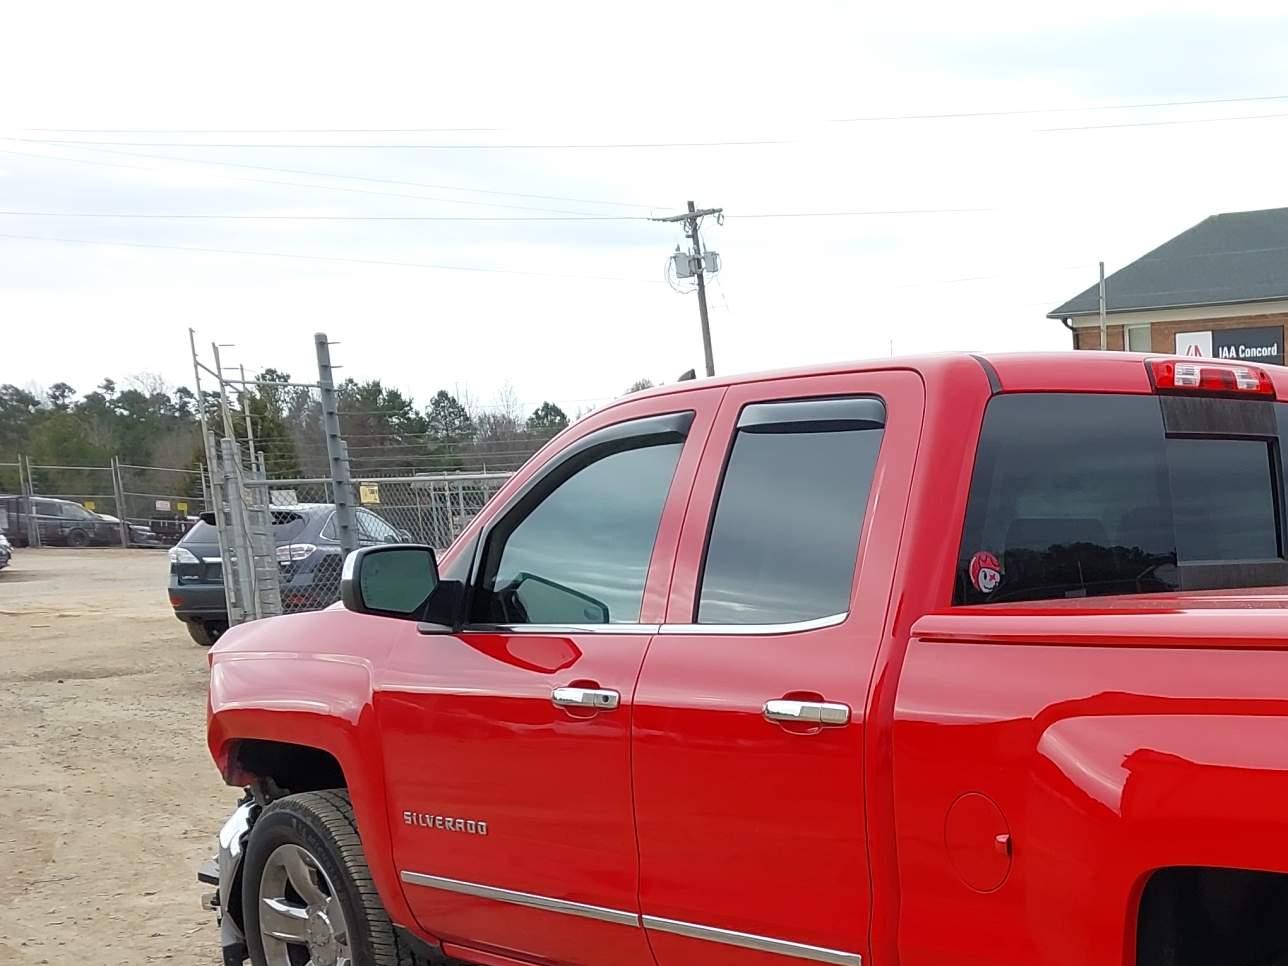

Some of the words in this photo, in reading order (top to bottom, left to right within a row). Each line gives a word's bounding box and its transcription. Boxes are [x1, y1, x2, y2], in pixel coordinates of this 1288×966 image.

[1219, 346, 1236, 358] IAA
[1239, 343, 1277, 358] Concord
[403, 811, 488, 835] SILVERADO
